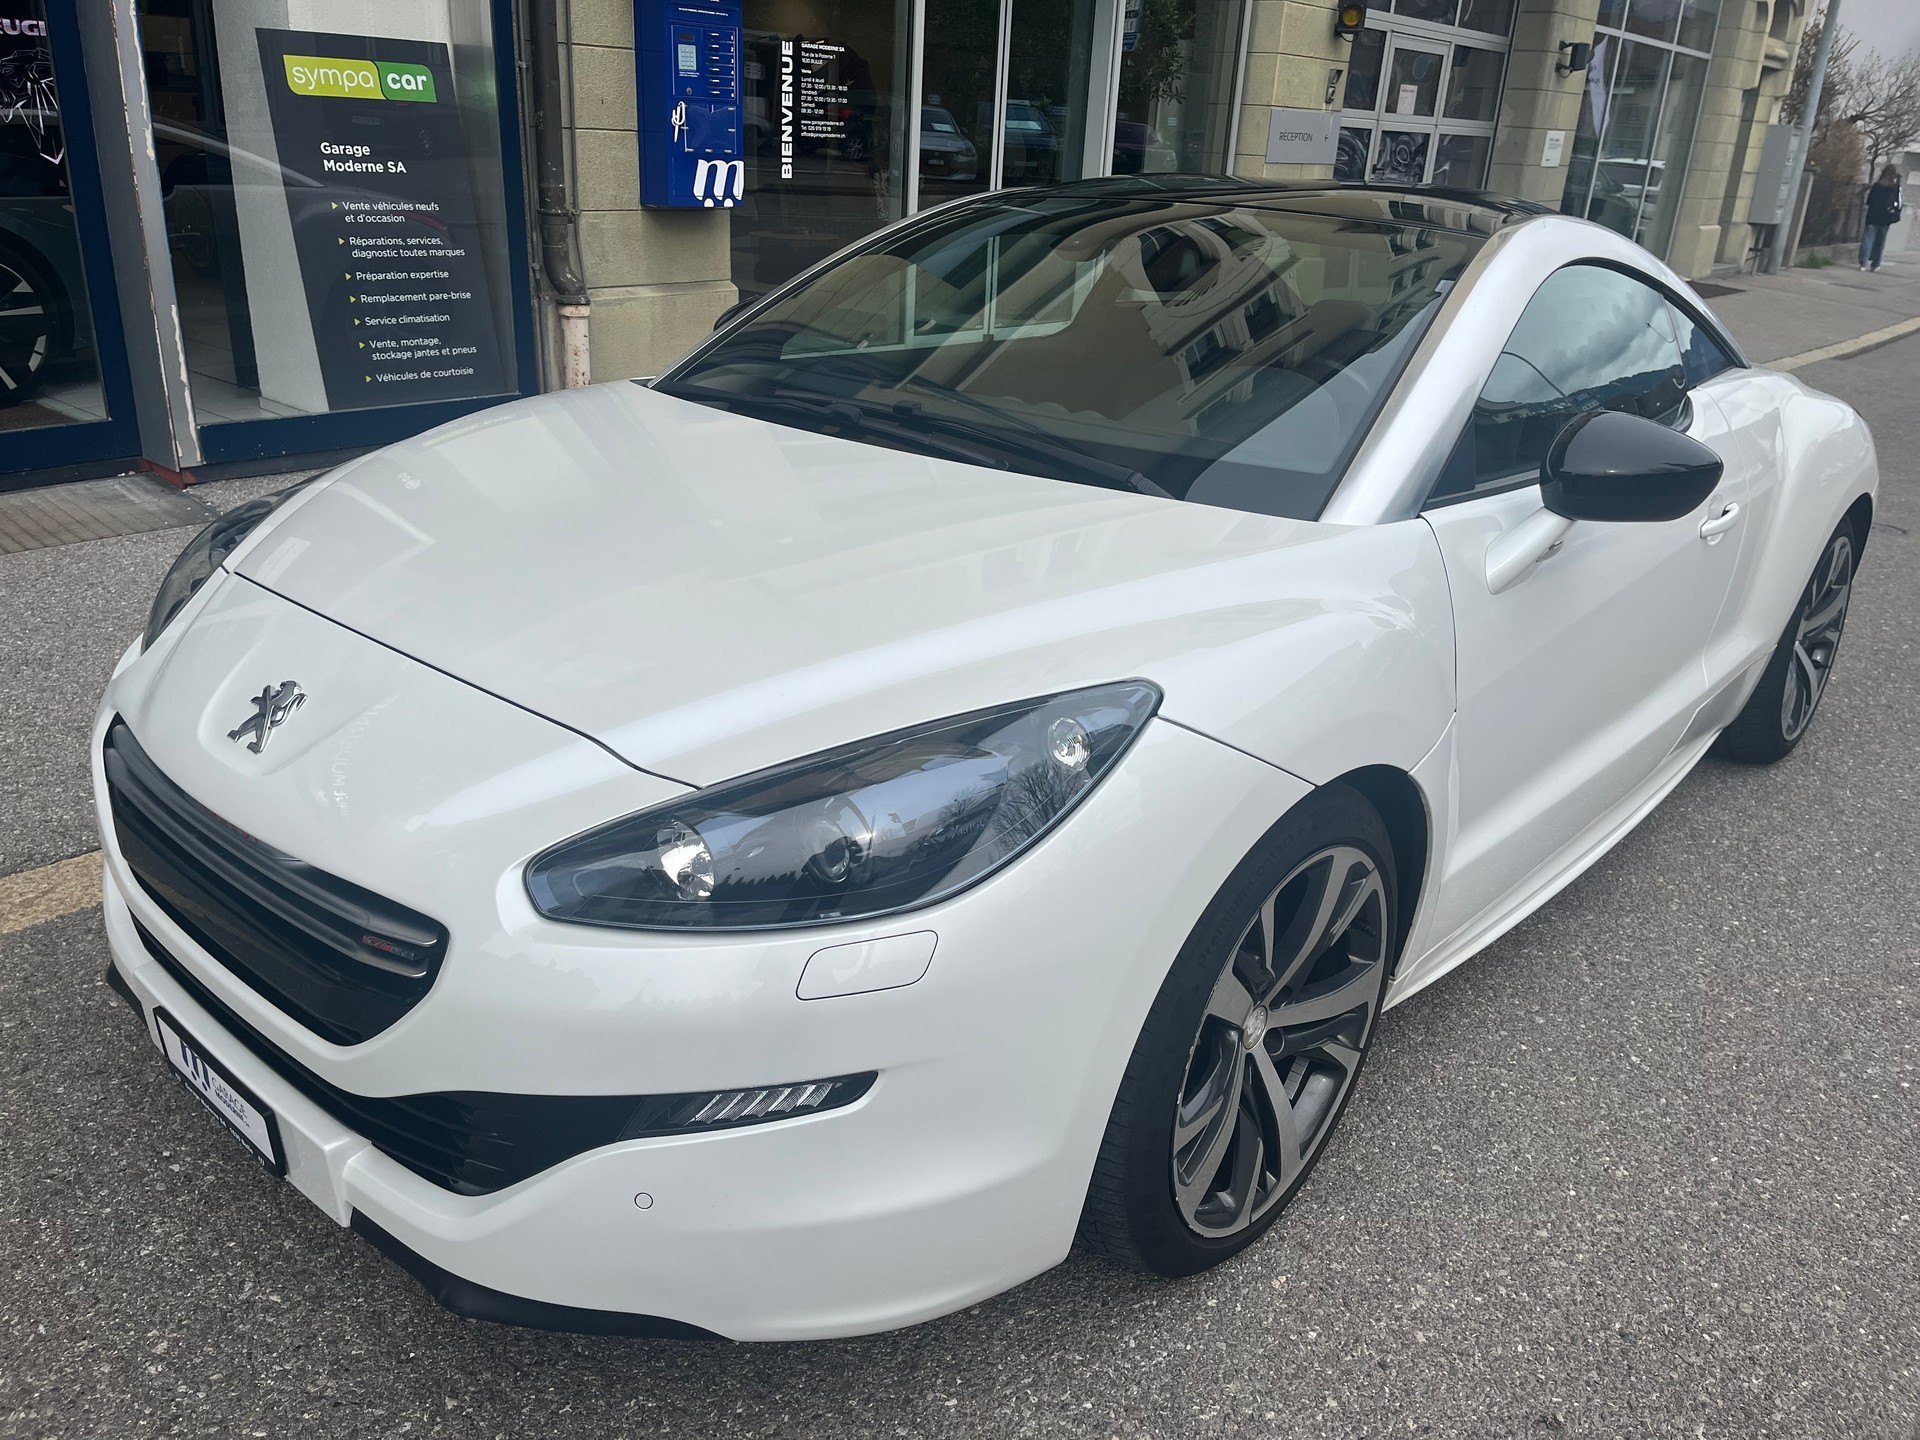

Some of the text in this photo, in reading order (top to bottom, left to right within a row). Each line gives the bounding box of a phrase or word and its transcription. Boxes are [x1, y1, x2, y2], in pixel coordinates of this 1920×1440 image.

[292, 66, 427, 92] sympa car
[781, 41, 793, 179] BIENVENUE
[1279, 130, 1313, 142] RÉCEPTION
[320, 142, 371, 157] Garage
[323, 160, 407, 173] Moderne SA
[342, 201, 439, 211] Vente véhicules neufs
[356, 214, 405, 222] d'occasion
[350, 236, 443, 247] Réparations, services,
[352, 249, 398, 259] diagnostic
[429, 249, 465, 258] marques
[356, 270, 449, 281] Préparation expertise
[360, 291, 471, 304] Remplacement pare-brise
[365, 314, 450, 326] Service climatisation
[369, 337, 442, 349] Vente, montage,
[372, 350, 412, 360] stockage
[414, 349, 440, 359] jantes
[452, 346, 477, 355] pneus
[376, 367, 474, 382] Véhicules de courtoisie
